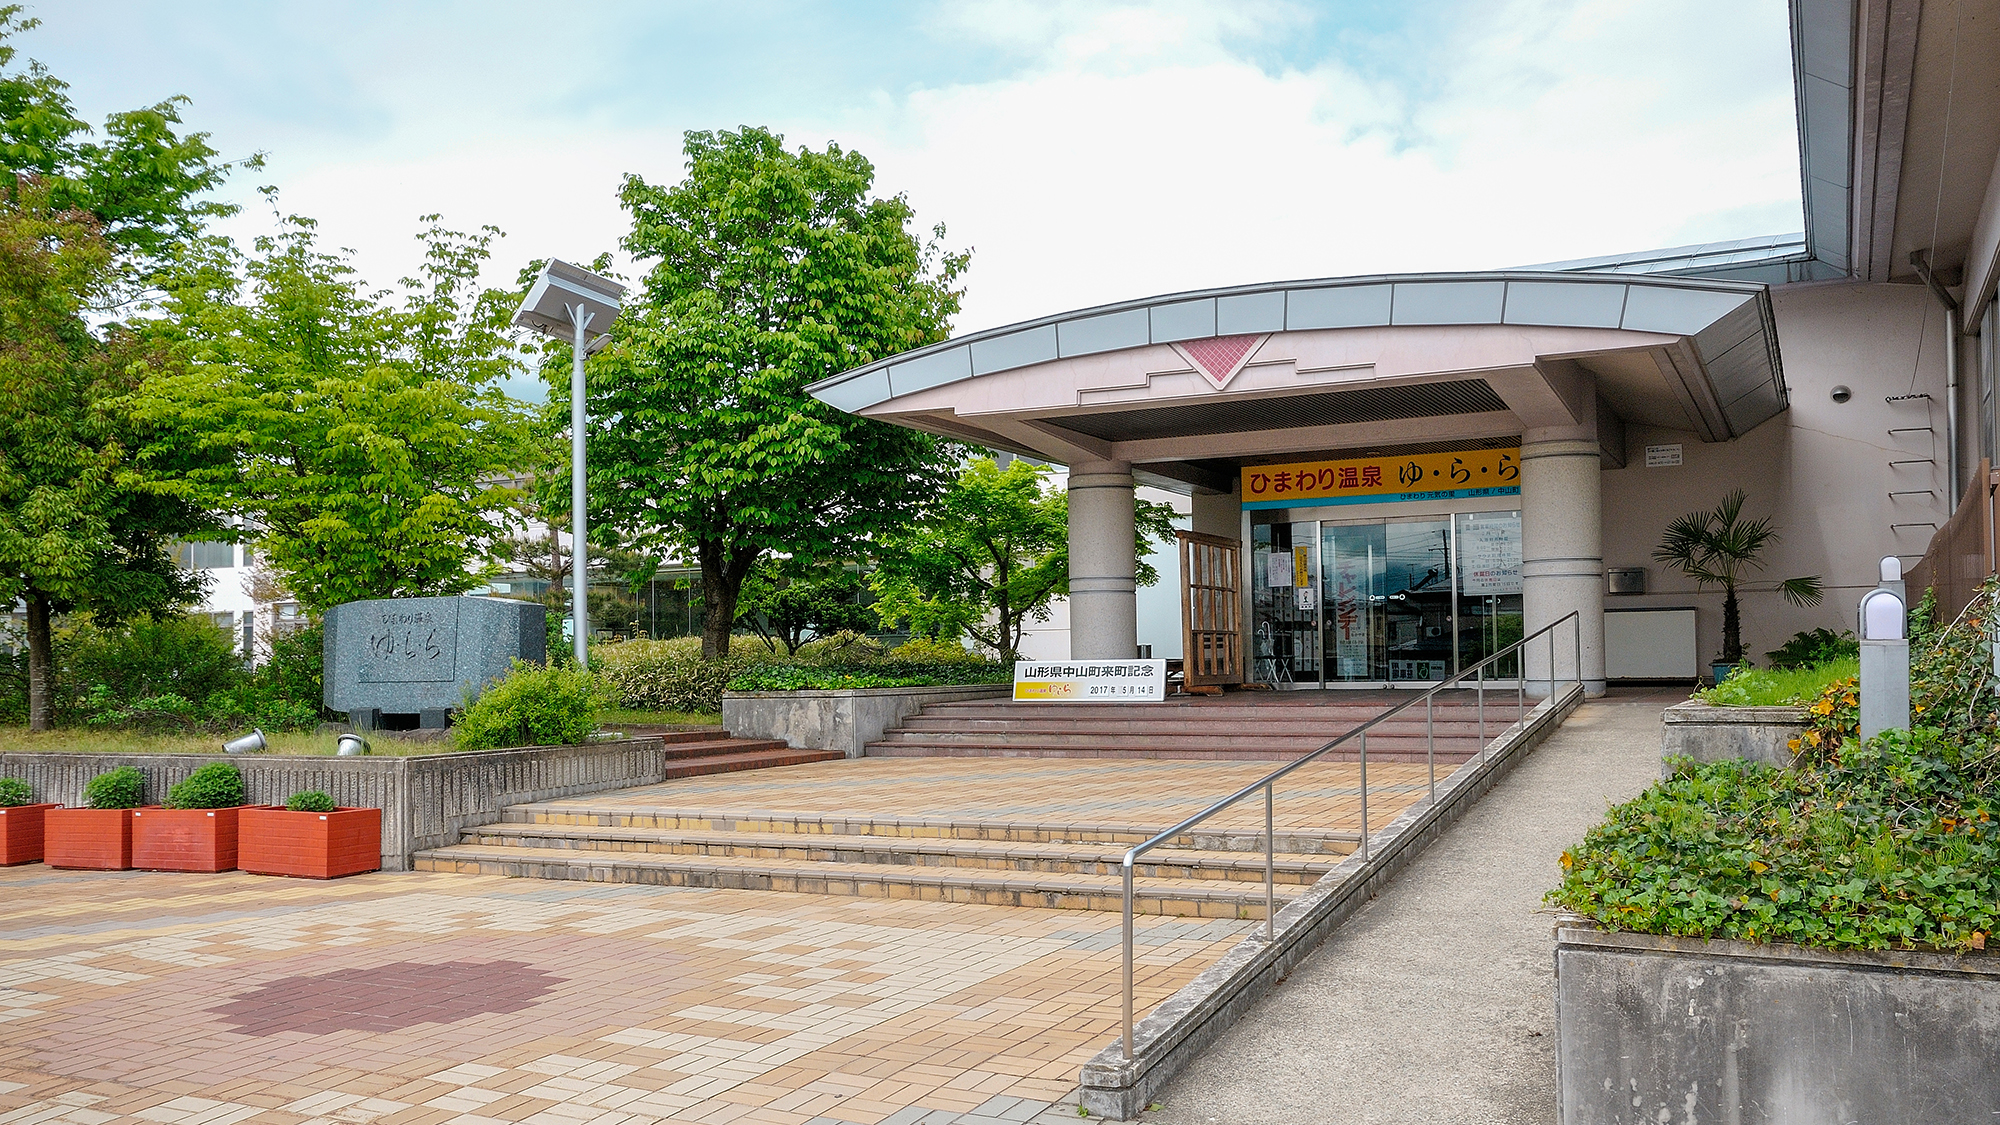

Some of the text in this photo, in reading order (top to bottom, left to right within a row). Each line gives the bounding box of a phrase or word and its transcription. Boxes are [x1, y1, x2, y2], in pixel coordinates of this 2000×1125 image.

[1250, 453, 1520, 494] ひまわり温泉 ゆ・ら・ら
[1336, 561, 1359, 640] チャレンジデー
[1024, 664, 1155, 678] 山形県中山町来町記念
